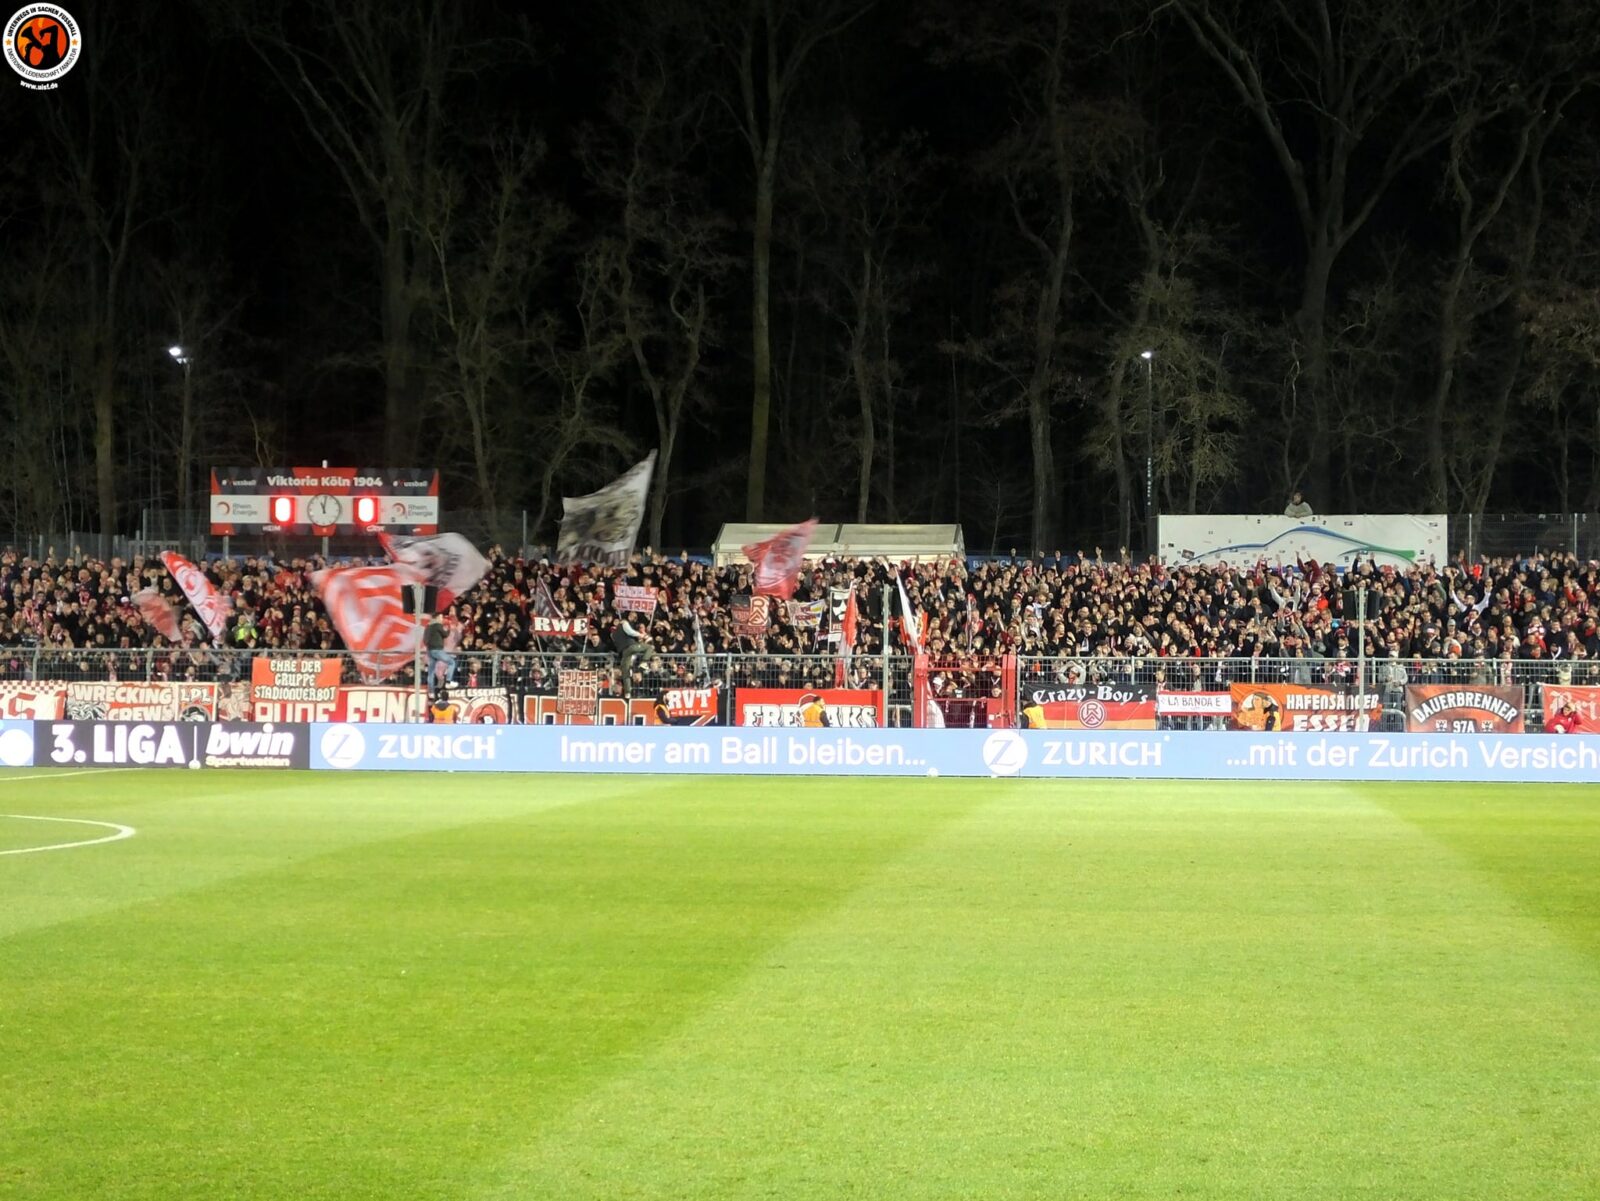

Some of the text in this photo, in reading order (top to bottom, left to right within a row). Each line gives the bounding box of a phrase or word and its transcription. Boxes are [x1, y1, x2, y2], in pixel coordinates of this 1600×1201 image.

[267, 475, 383, 487] Viktoria Köln 1904
[534, 616, 588, 634] RWE
[270, 660, 321, 673] EHRE DER
[275, 673, 315, 687] GRUPPE
[73, 684, 173, 705] WRECKING
[667, 690, 712, 709] RVT
[1182, 697, 1213, 707] BANDA
[1411, 691, 1518, 723] DAUERBRENNER
[50, 724, 186, 764] 3. LIGA
[205, 722, 295, 756] bwin
[378, 734, 496, 760] ZURICH
[560, 735, 927, 766] Immer am Ball bleiben...
[1041, 741, 1163, 766] ZURICH
[1226, 739, 1600, 769] ...mit der Zurich Versich
